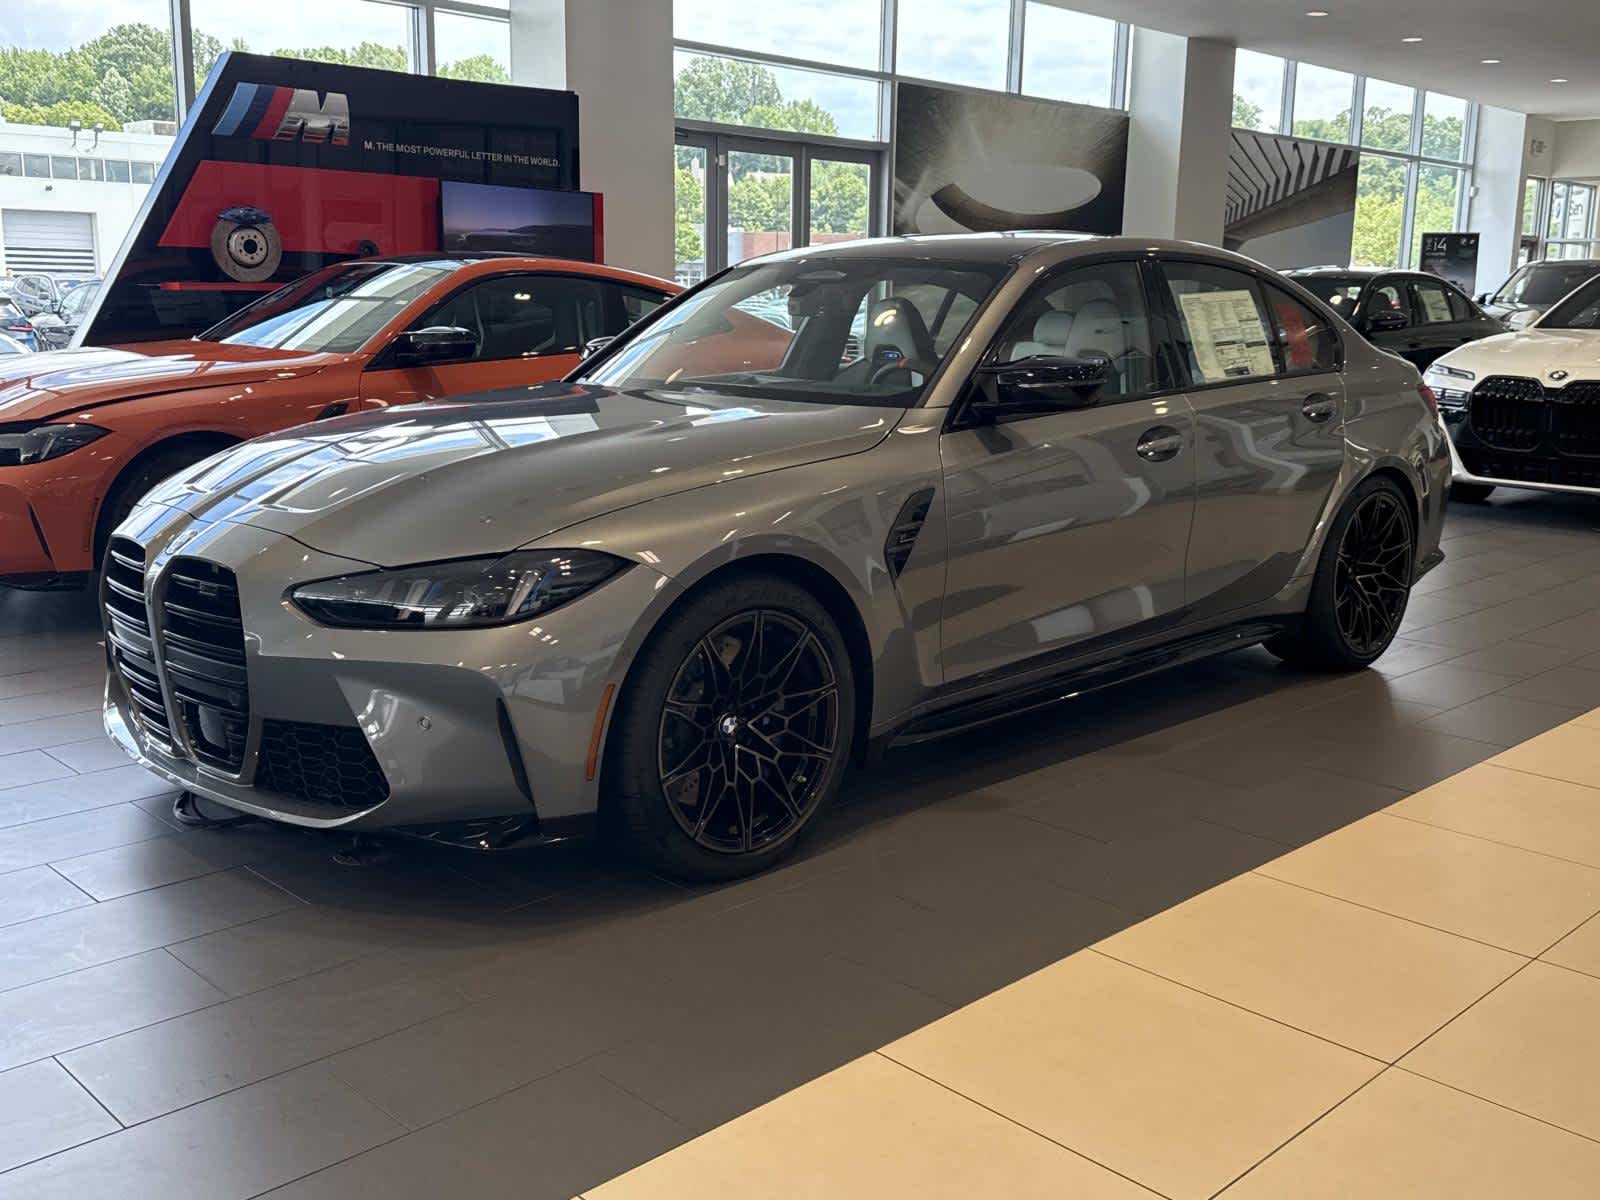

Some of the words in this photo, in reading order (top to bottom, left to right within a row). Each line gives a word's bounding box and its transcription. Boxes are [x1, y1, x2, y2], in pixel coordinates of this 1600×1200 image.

[272, 88, 350, 146] M
[364, 140, 375, 151] M.
[376, 141, 395, 152] THE
[396, 143, 422, 154] MOST
[423, 145, 470, 160] POWERFUL
[471, 151, 503, 162] LETTER
[504, 154, 513, 163] IN
[513, 154, 529, 165] THE
[530, 156, 561, 167] WORLD.
